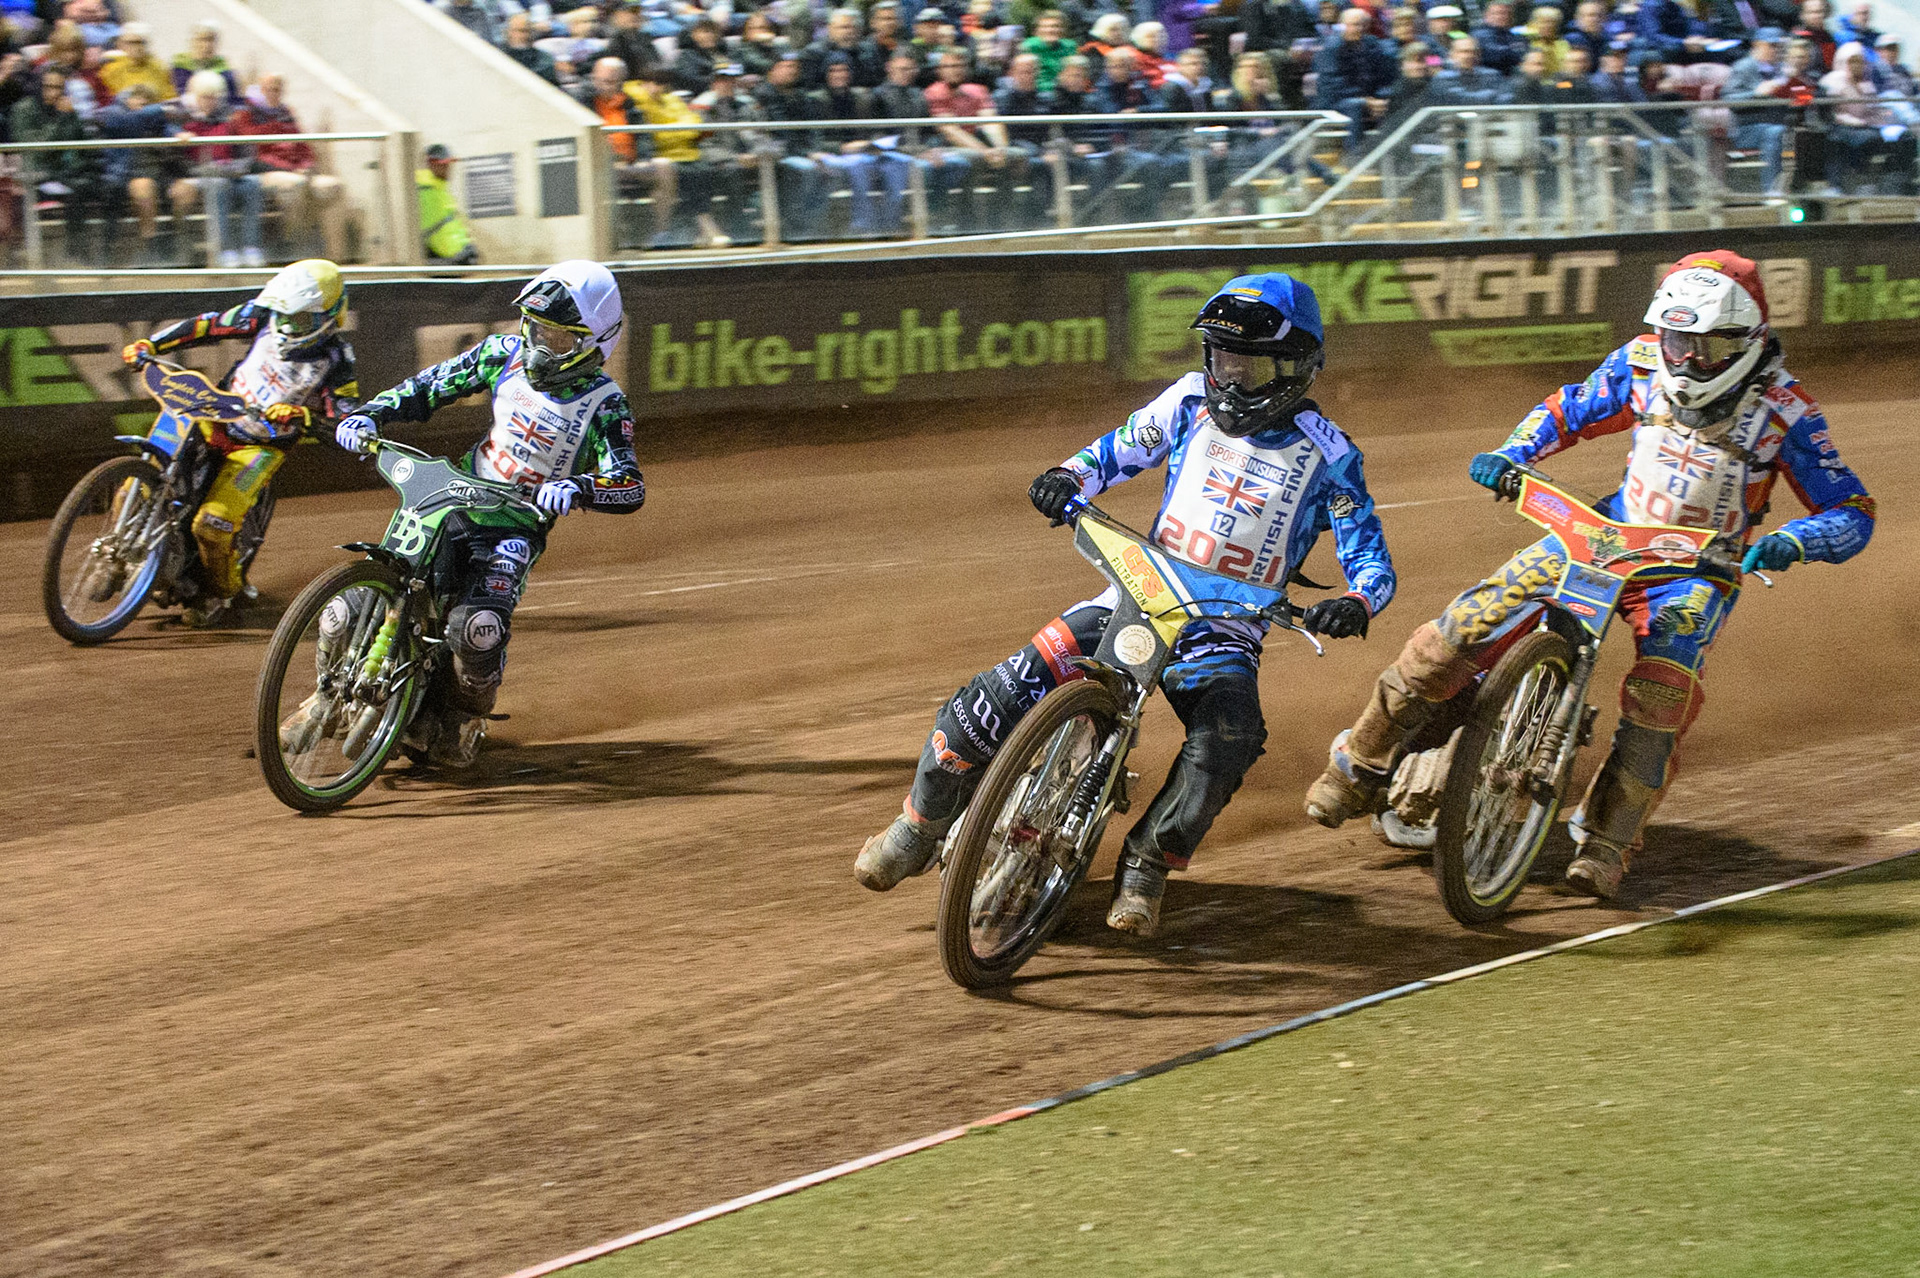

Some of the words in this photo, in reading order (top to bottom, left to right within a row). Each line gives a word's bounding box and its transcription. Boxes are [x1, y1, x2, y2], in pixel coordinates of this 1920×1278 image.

[1248, 251, 1618, 324] IKERIGHT
[650, 308, 1106, 395] bike-right.com
[513, 391, 541, 415] SPORTS
[539, 409, 571, 431] INSURE
[550, 449, 571, 479] TISH
[567, 398, 593, 446] FINAL
[1209, 444, 1248, 468] SPORTS
[1249, 459, 1286, 485] INSURE
[1282, 442, 1313, 505] FINAL
[1213, 514, 1235, 536] 12
[1629, 474, 1739, 533] 2021
[1713, 473, 1737, 529] RITISH
[1122, 544, 1164, 598] CFS
[1158, 514, 1283, 584] 2021
[1110, 557, 1149, 607] FILTRATION
[1450, 546, 1549, 622] KEVIN
[325, 604, 339, 628] ATPI
[473, 624, 498, 639] ATPI
